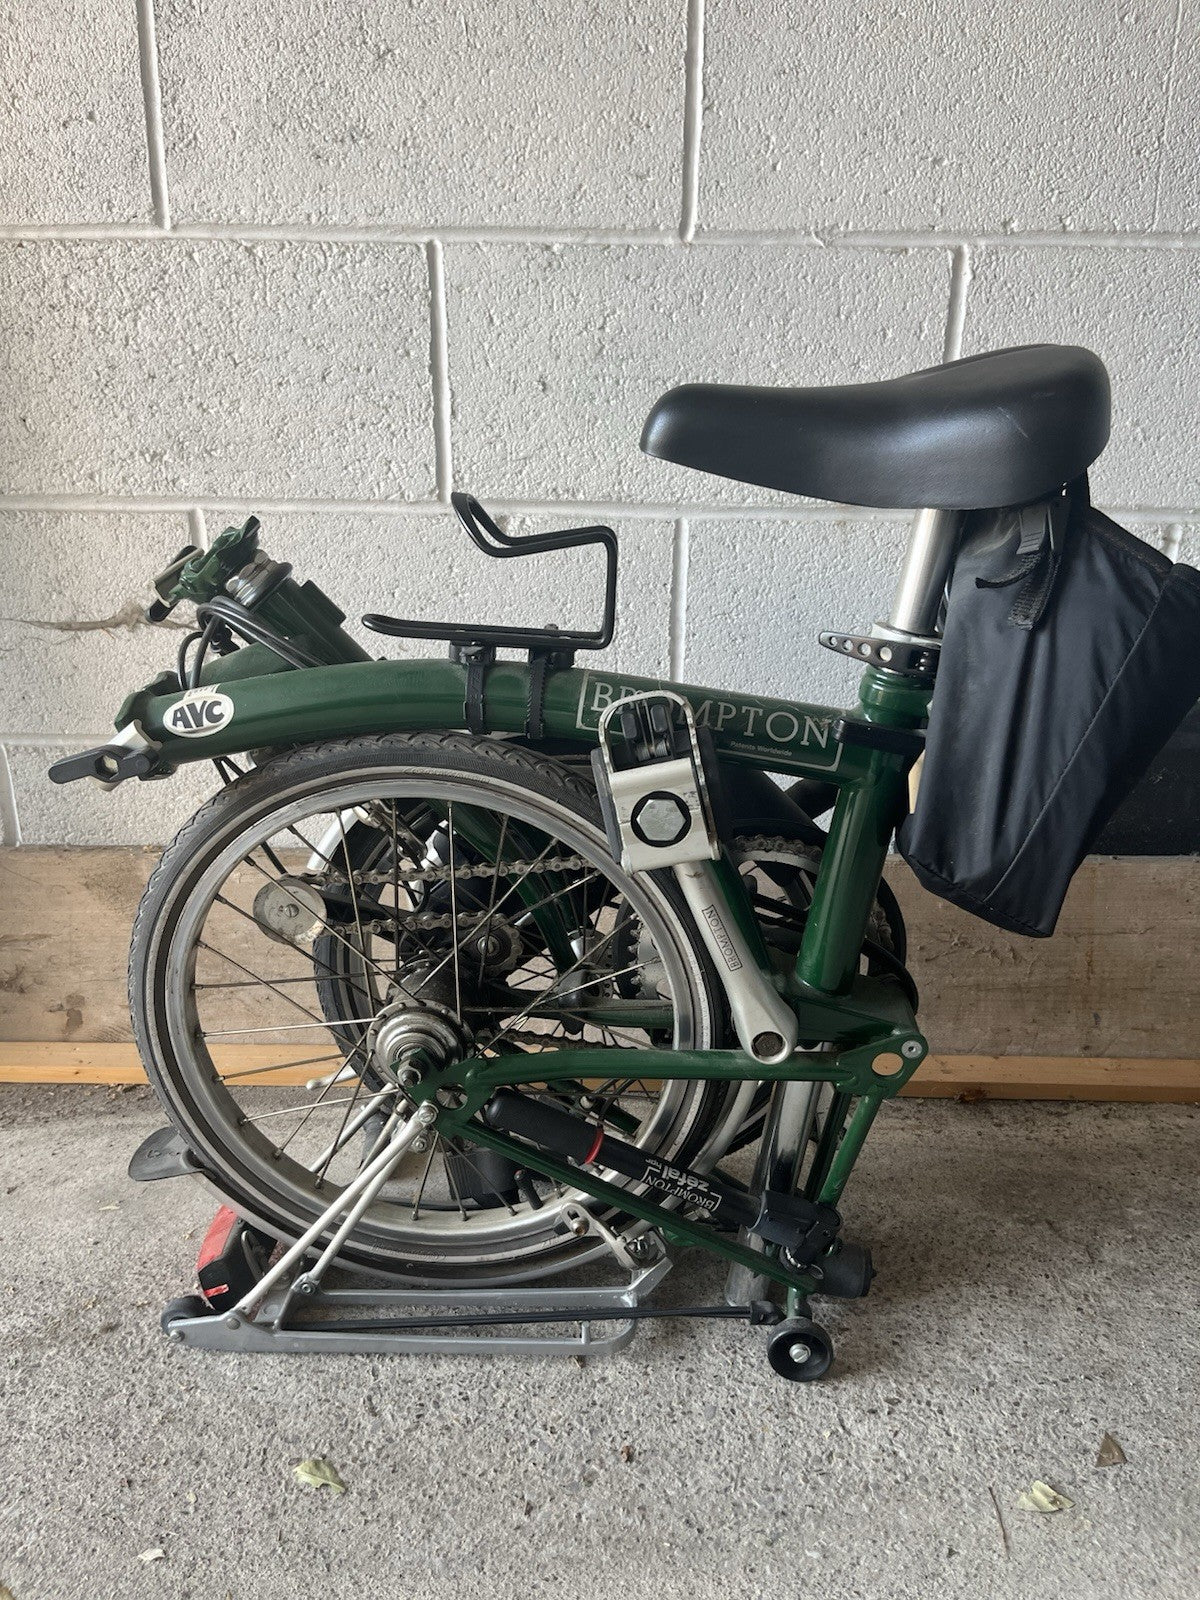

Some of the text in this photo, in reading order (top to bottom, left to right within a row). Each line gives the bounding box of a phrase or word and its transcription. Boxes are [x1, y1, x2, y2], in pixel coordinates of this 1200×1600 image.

[172, 700, 225, 729] AVC
[705, 908, 740, 969] BROMPTON
[645, 1175, 715, 1210] BROMPTON
[661, 1165, 710, 1193] zéfal
